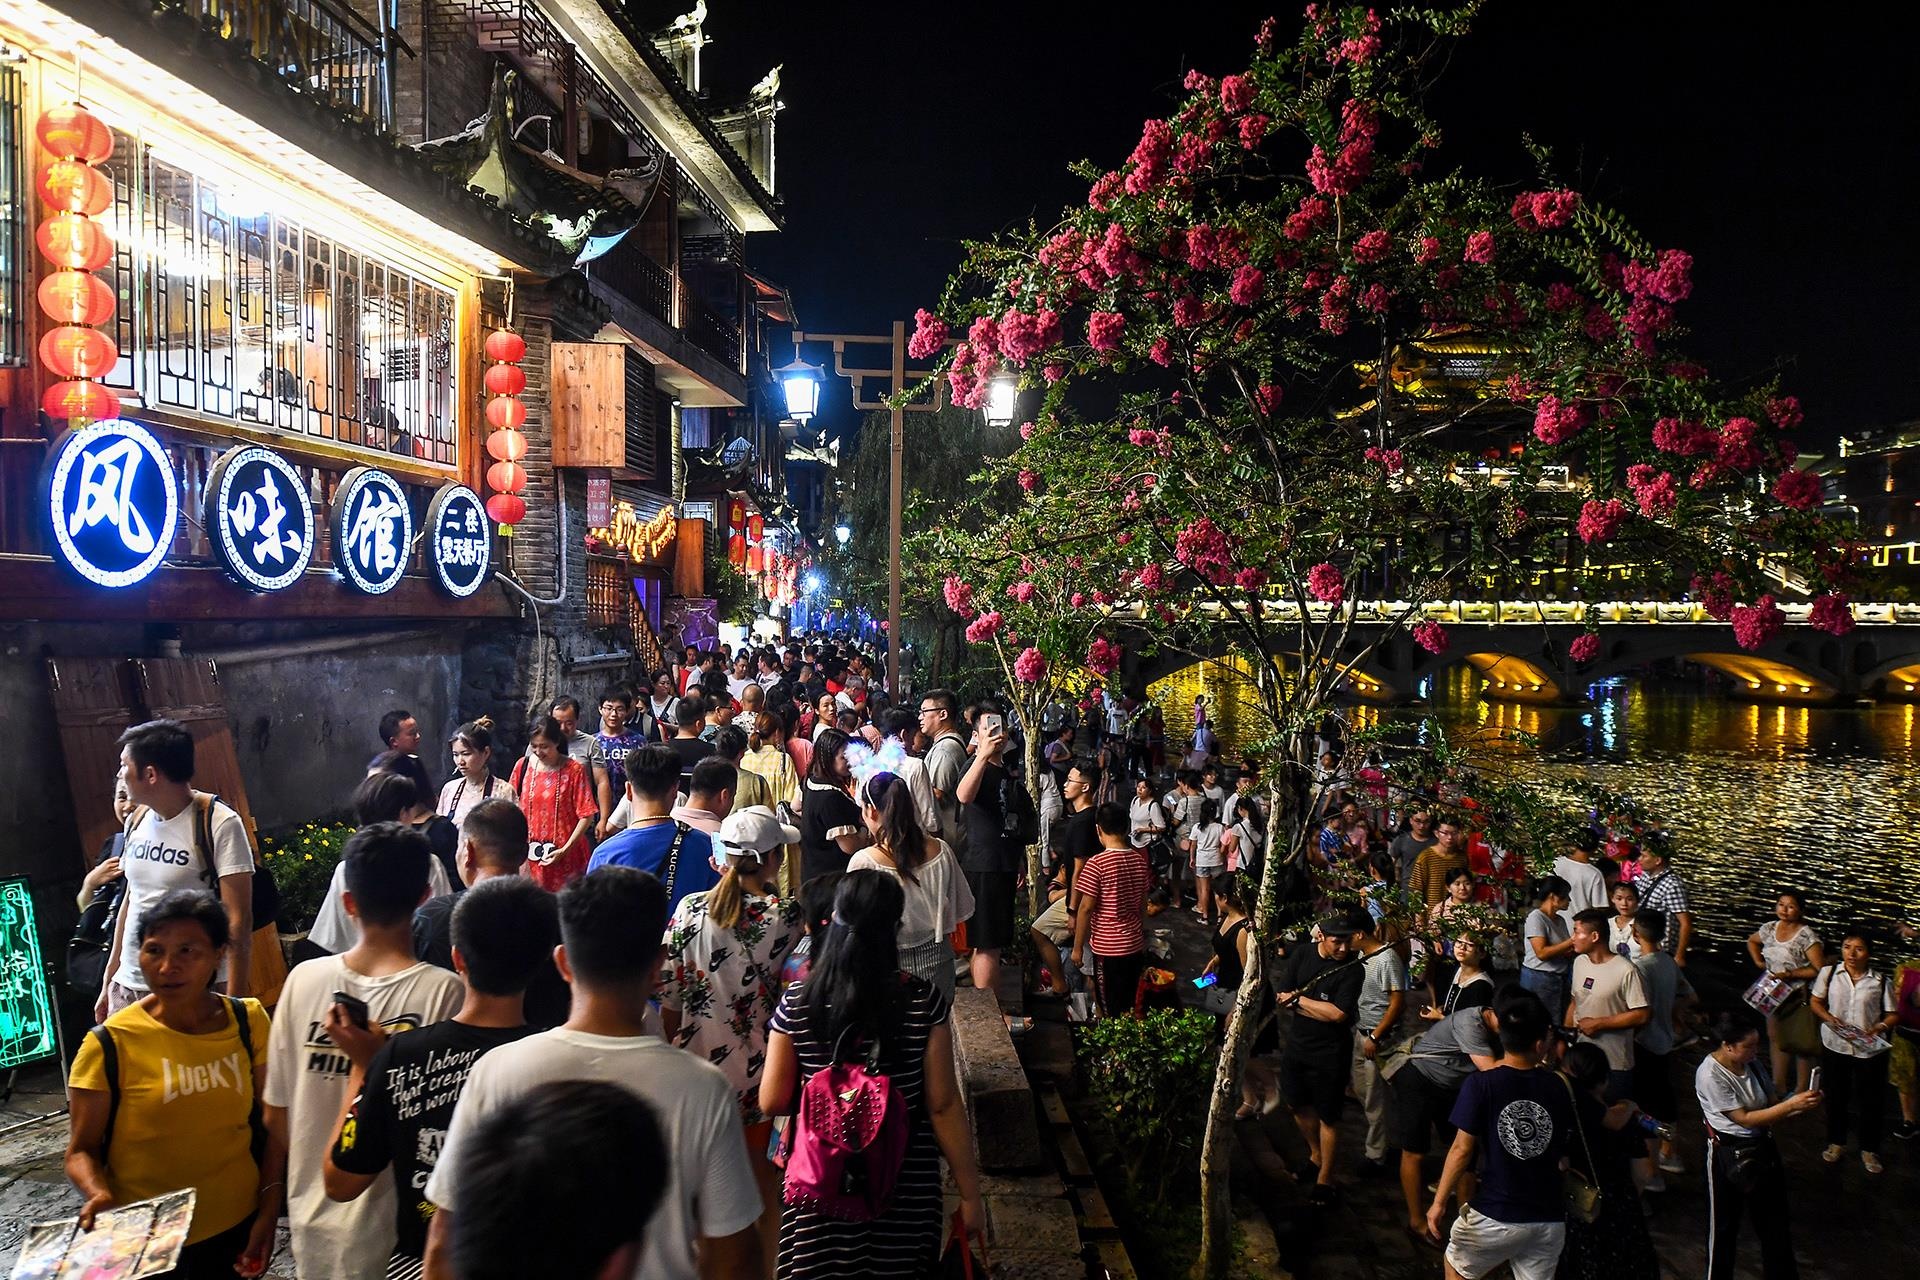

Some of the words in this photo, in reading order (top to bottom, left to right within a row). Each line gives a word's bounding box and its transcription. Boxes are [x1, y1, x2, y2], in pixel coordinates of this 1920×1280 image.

[445, 506, 479, 533] 二楼
[161, 1052, 244, 1105] LUCKY
[386, 1066, 407, 1090] It
[408, 1062, 422, 1081] is
[425, 1048, 480, 1075] labour
[392, 1076, 428, 1105] that
[398, 1101, 422, 1121] the
